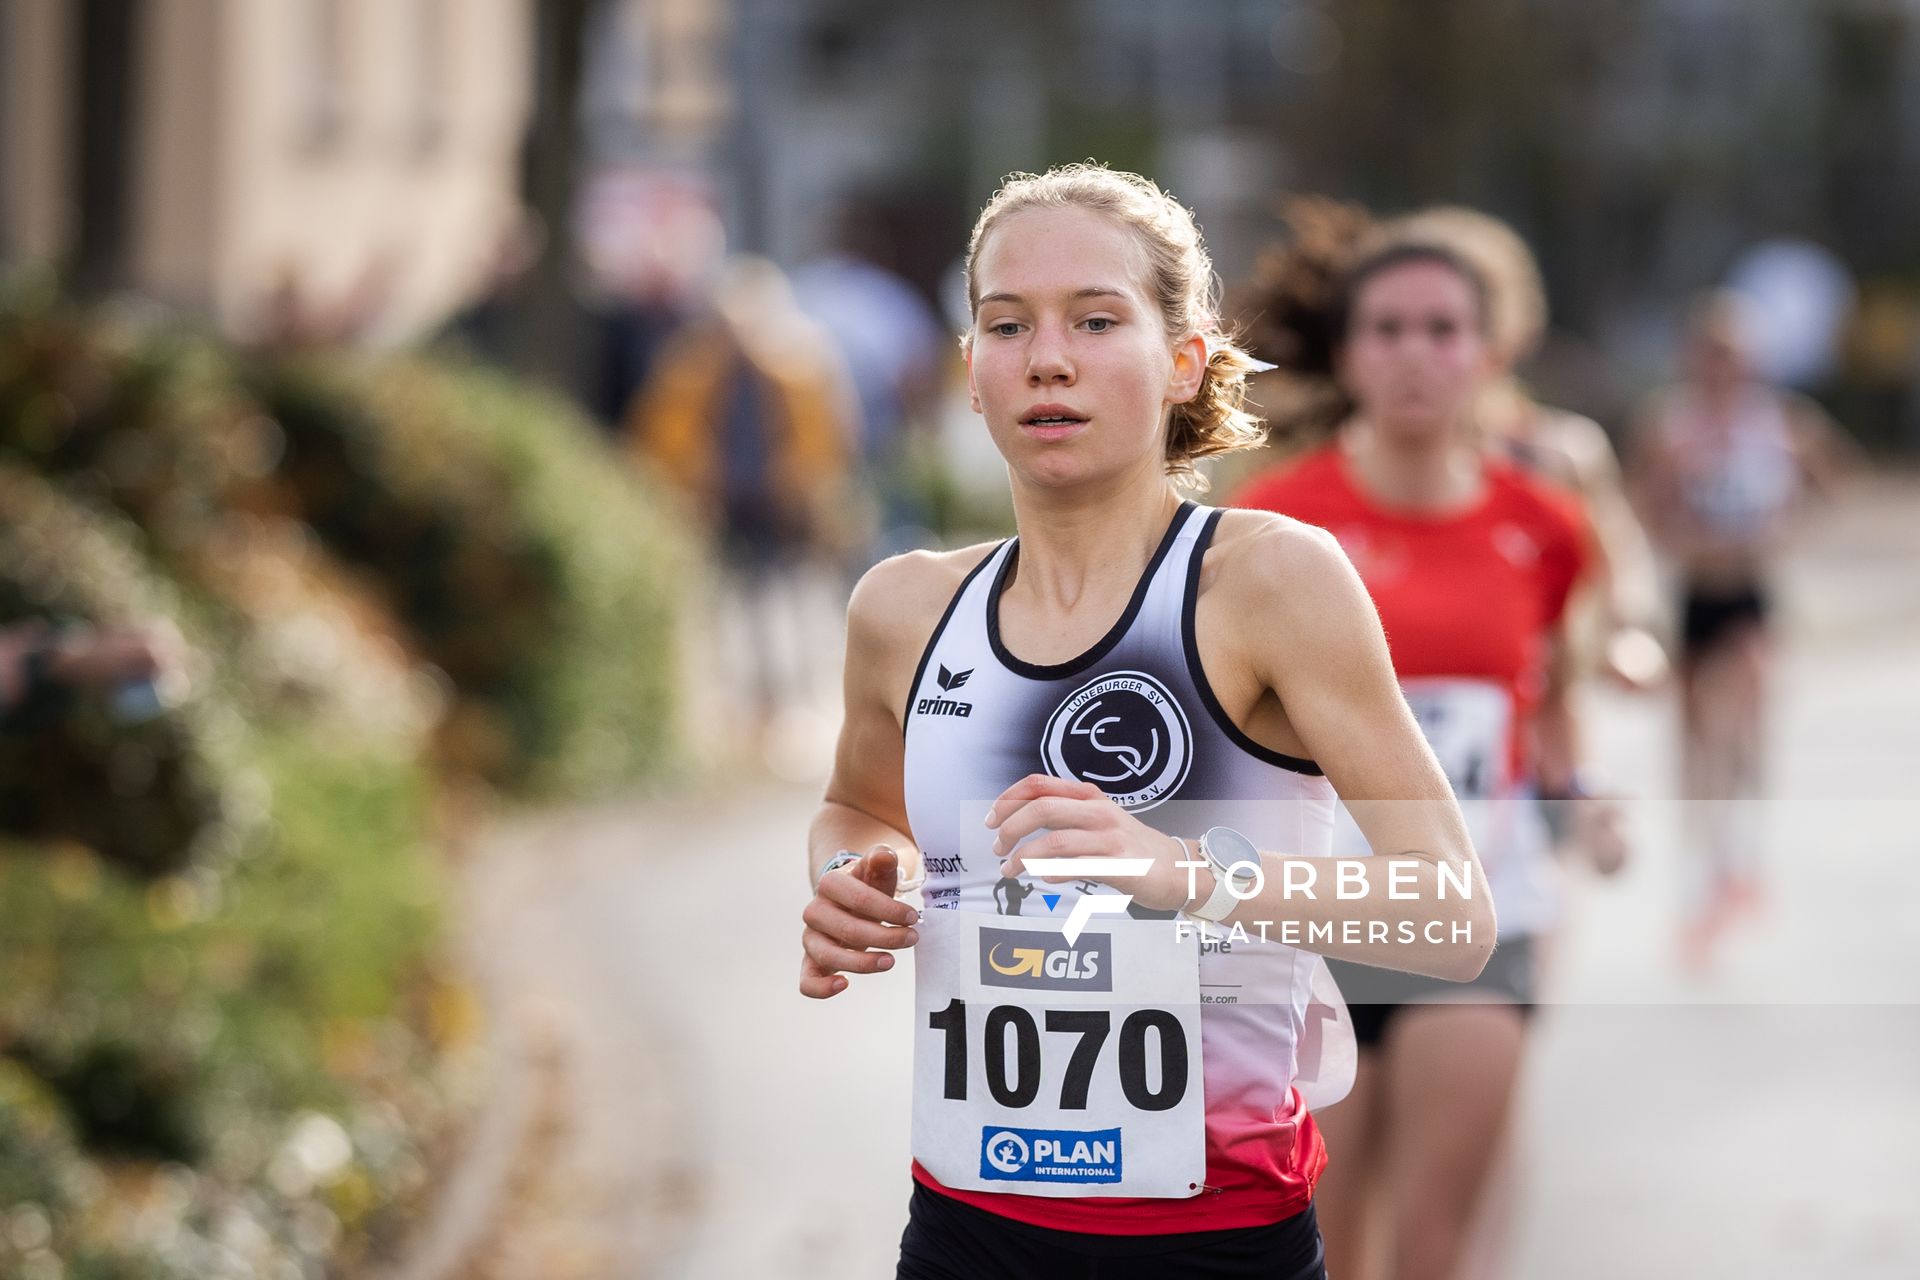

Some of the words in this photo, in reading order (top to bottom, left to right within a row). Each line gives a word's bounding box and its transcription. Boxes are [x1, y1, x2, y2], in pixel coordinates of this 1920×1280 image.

[917, 695, 973, 718] erima
[1147, 690, 1164, 706] SV
[1140, 784, 1163, 801] e.V.
[1045, 950, 1099, 979] GLS
[929, 998, 1189, 1111] 1070
[1034, 1139, 1115, 1164] PLAN
[1035, 1166, 1115, 1176] INTERNATIONAL
